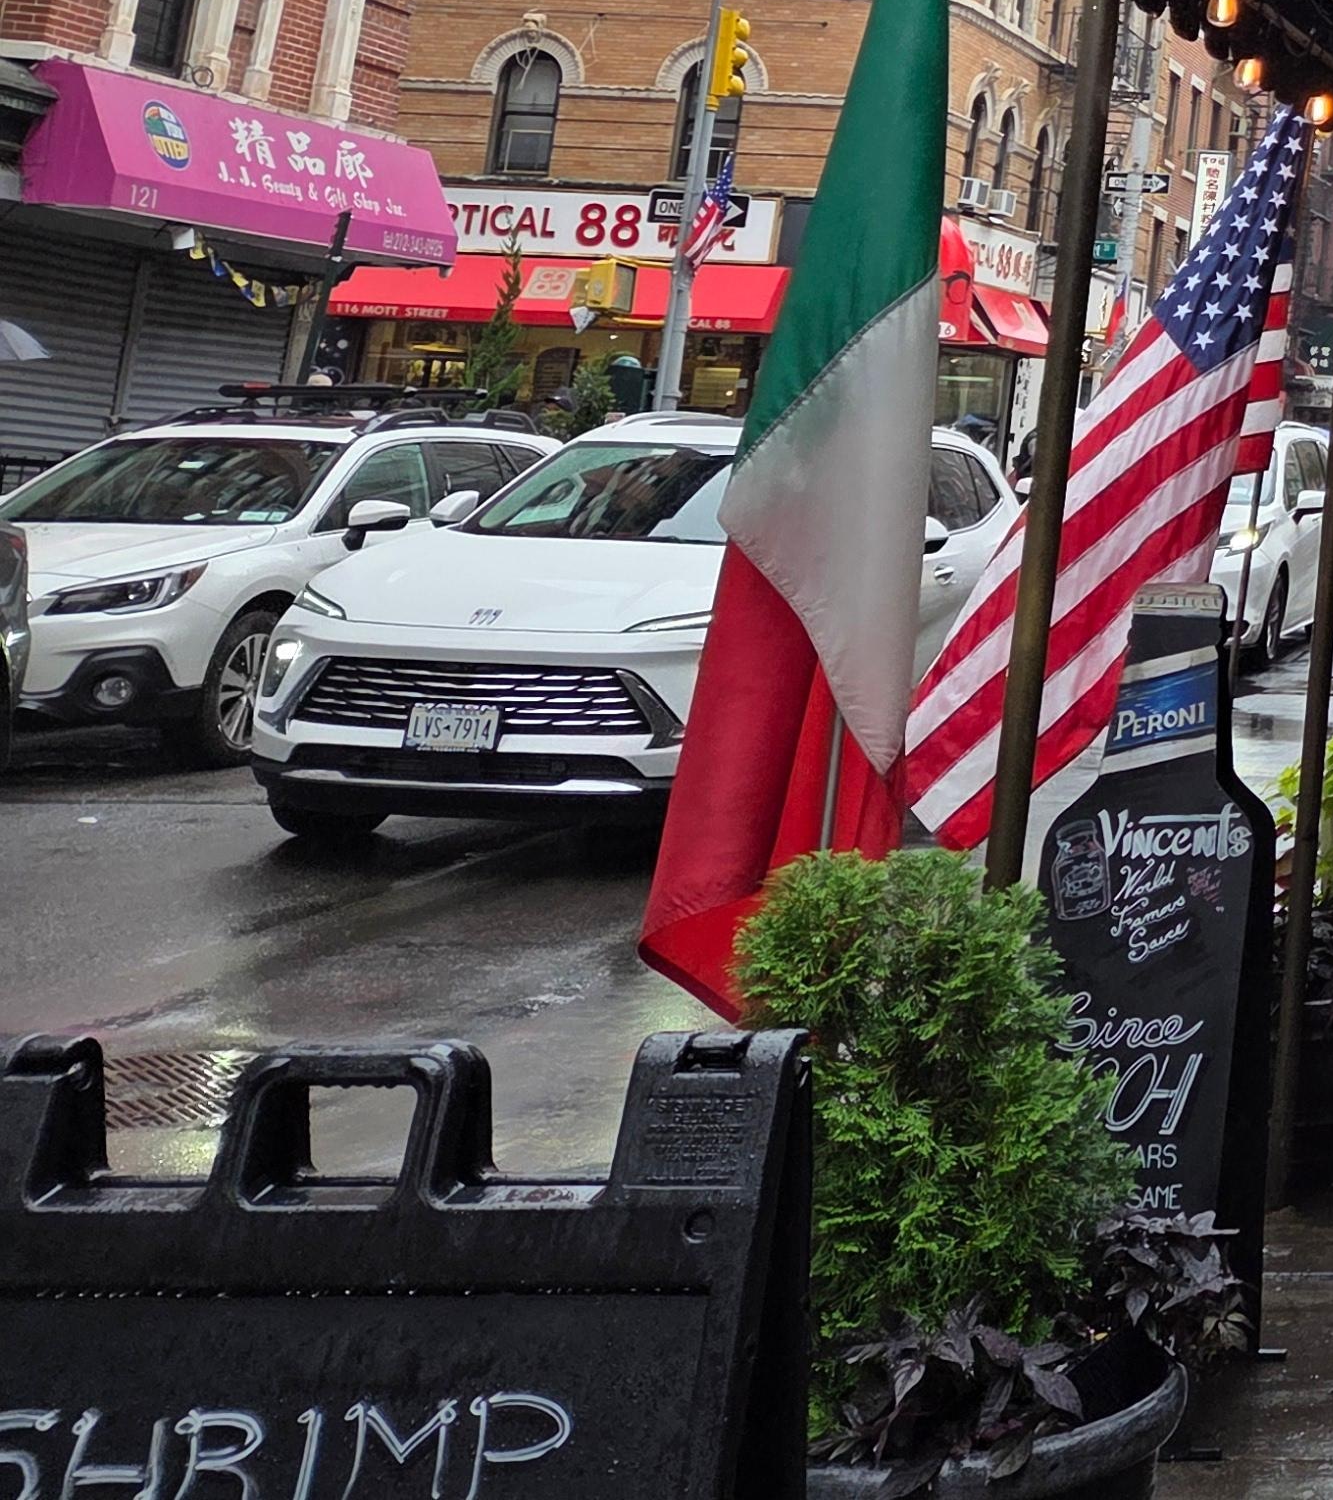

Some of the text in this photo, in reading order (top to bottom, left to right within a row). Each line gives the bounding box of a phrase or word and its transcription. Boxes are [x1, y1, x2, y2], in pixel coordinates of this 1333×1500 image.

[130, 183, 158, 210] 121
[307, 182, 318, 201] &
[575, 202, 643, 249] 88
[336, 303, 449, 318] 116 MOTT STREET
[688, 318, 711, 329] CAL
[452, 717, 492, 741] 7914
[1112, 701, 1207, 742] PERONI
[1097, 802, 1253, 861] Vincent's
[1113, 858, 1177, 902] World
[1127, 919, 1191, 963] Sauce
[1055, 991, 1204, 1052] Since
[1072, 1052, 1203, 1136] 04
[1125, 1183, 1183, 1211] SAME
[0, 1391, 573, 1500] SHRIMP
